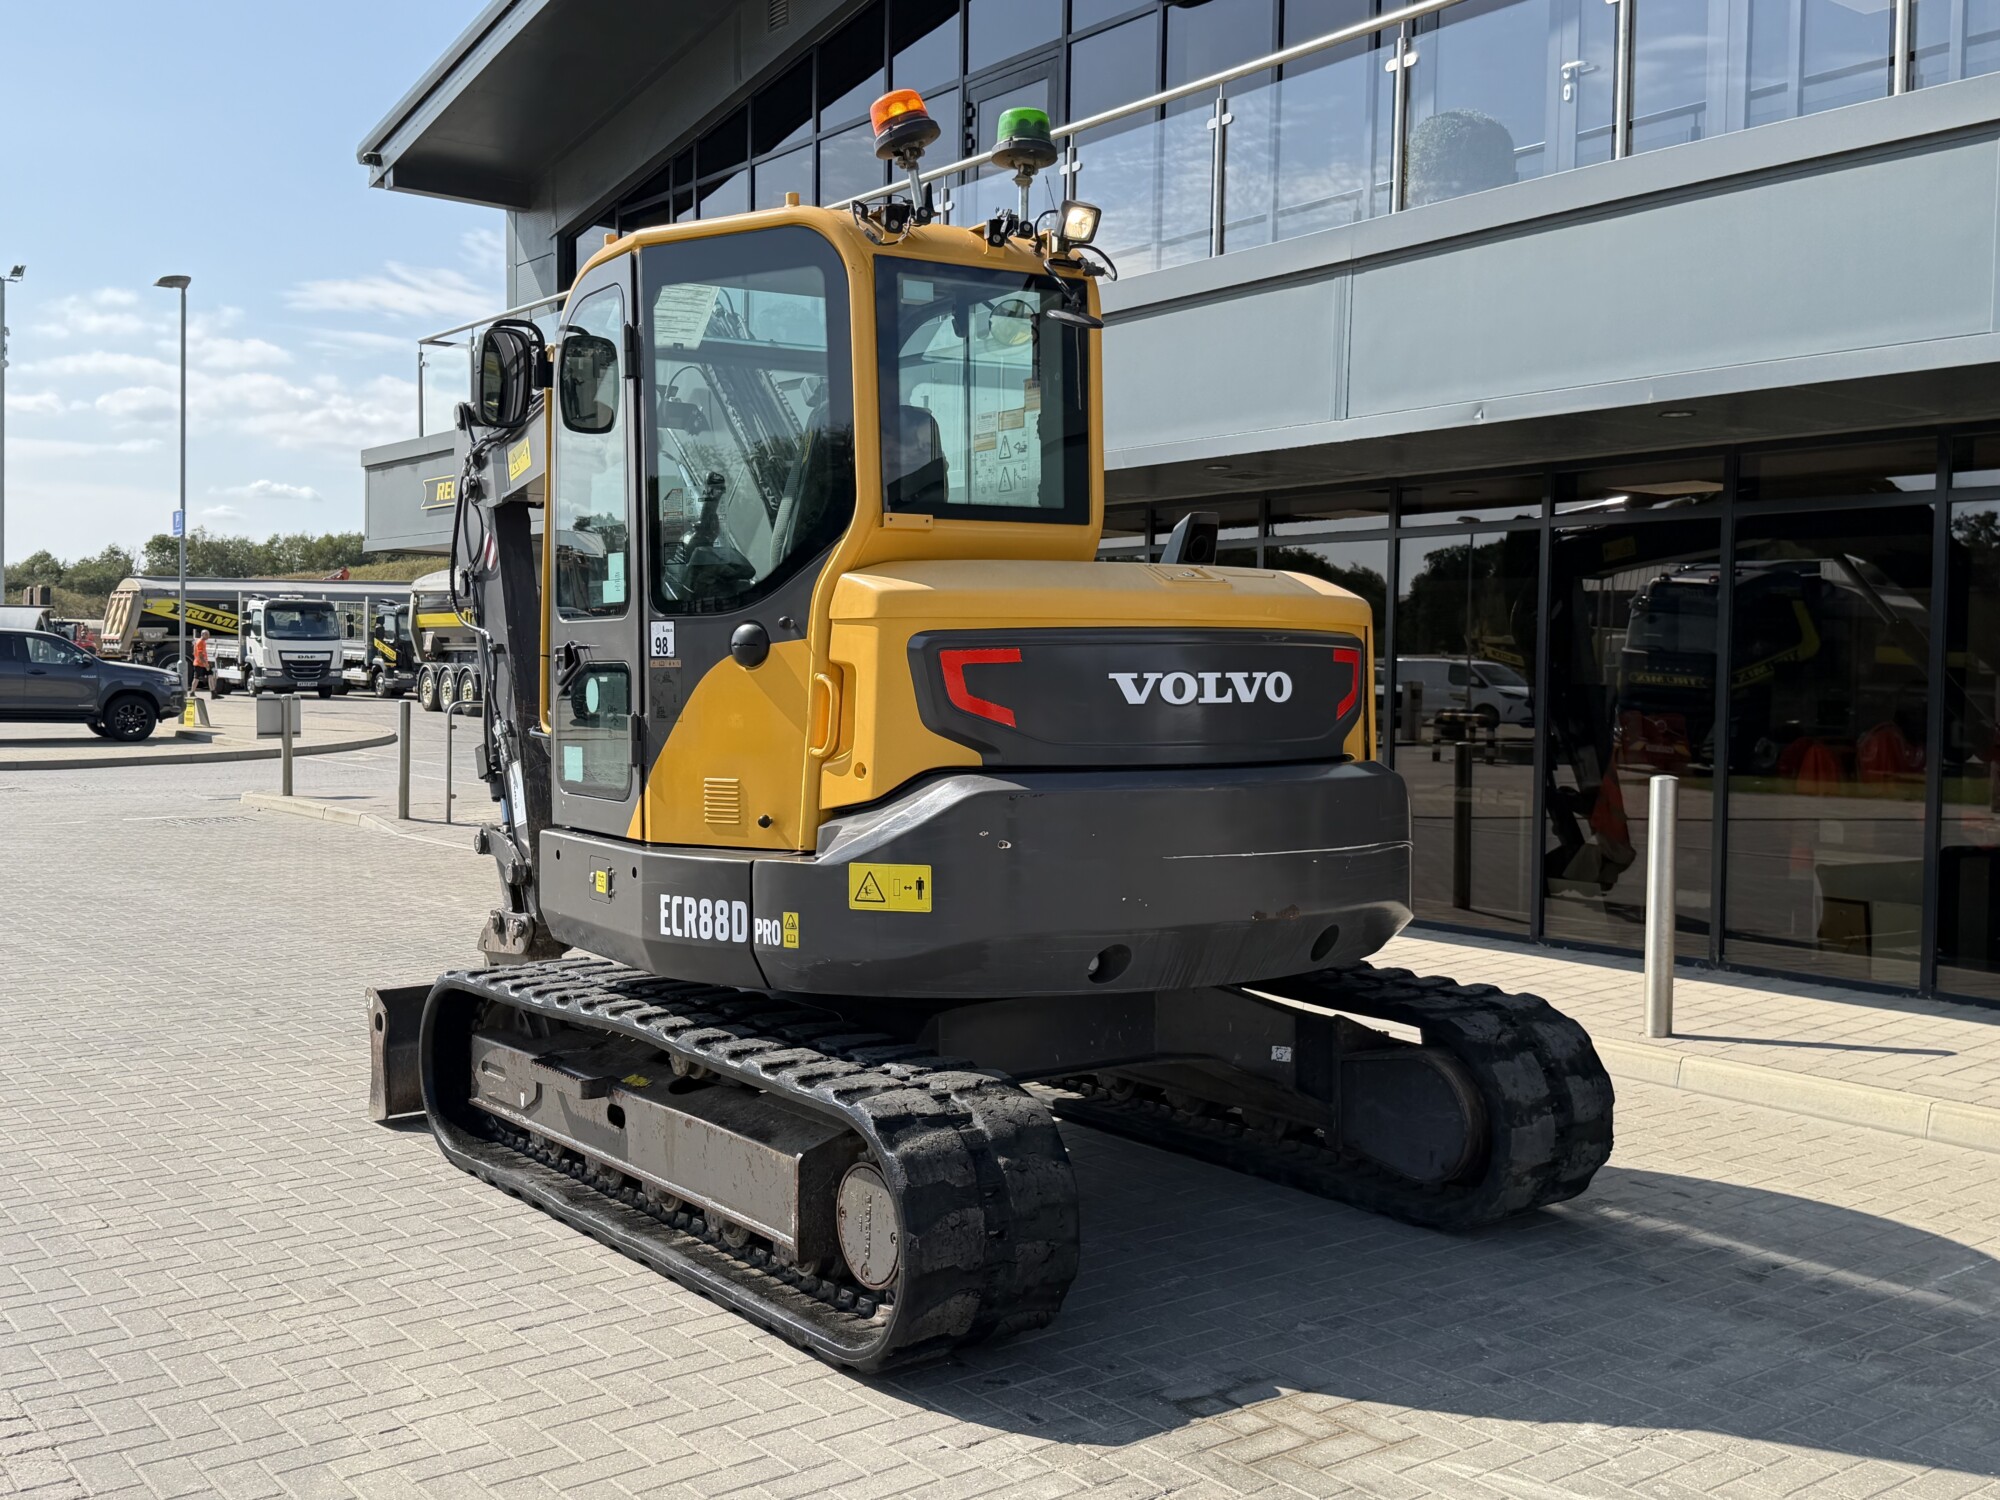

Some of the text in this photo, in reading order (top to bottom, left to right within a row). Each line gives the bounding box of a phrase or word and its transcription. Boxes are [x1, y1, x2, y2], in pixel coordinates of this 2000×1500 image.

[213, 615, 239, 629] MI
[655, 637, 668, 655] 98
[1108, 671, 1293, 705] VOLVO
[660, 894, 781, 946] ECR88D PRO
